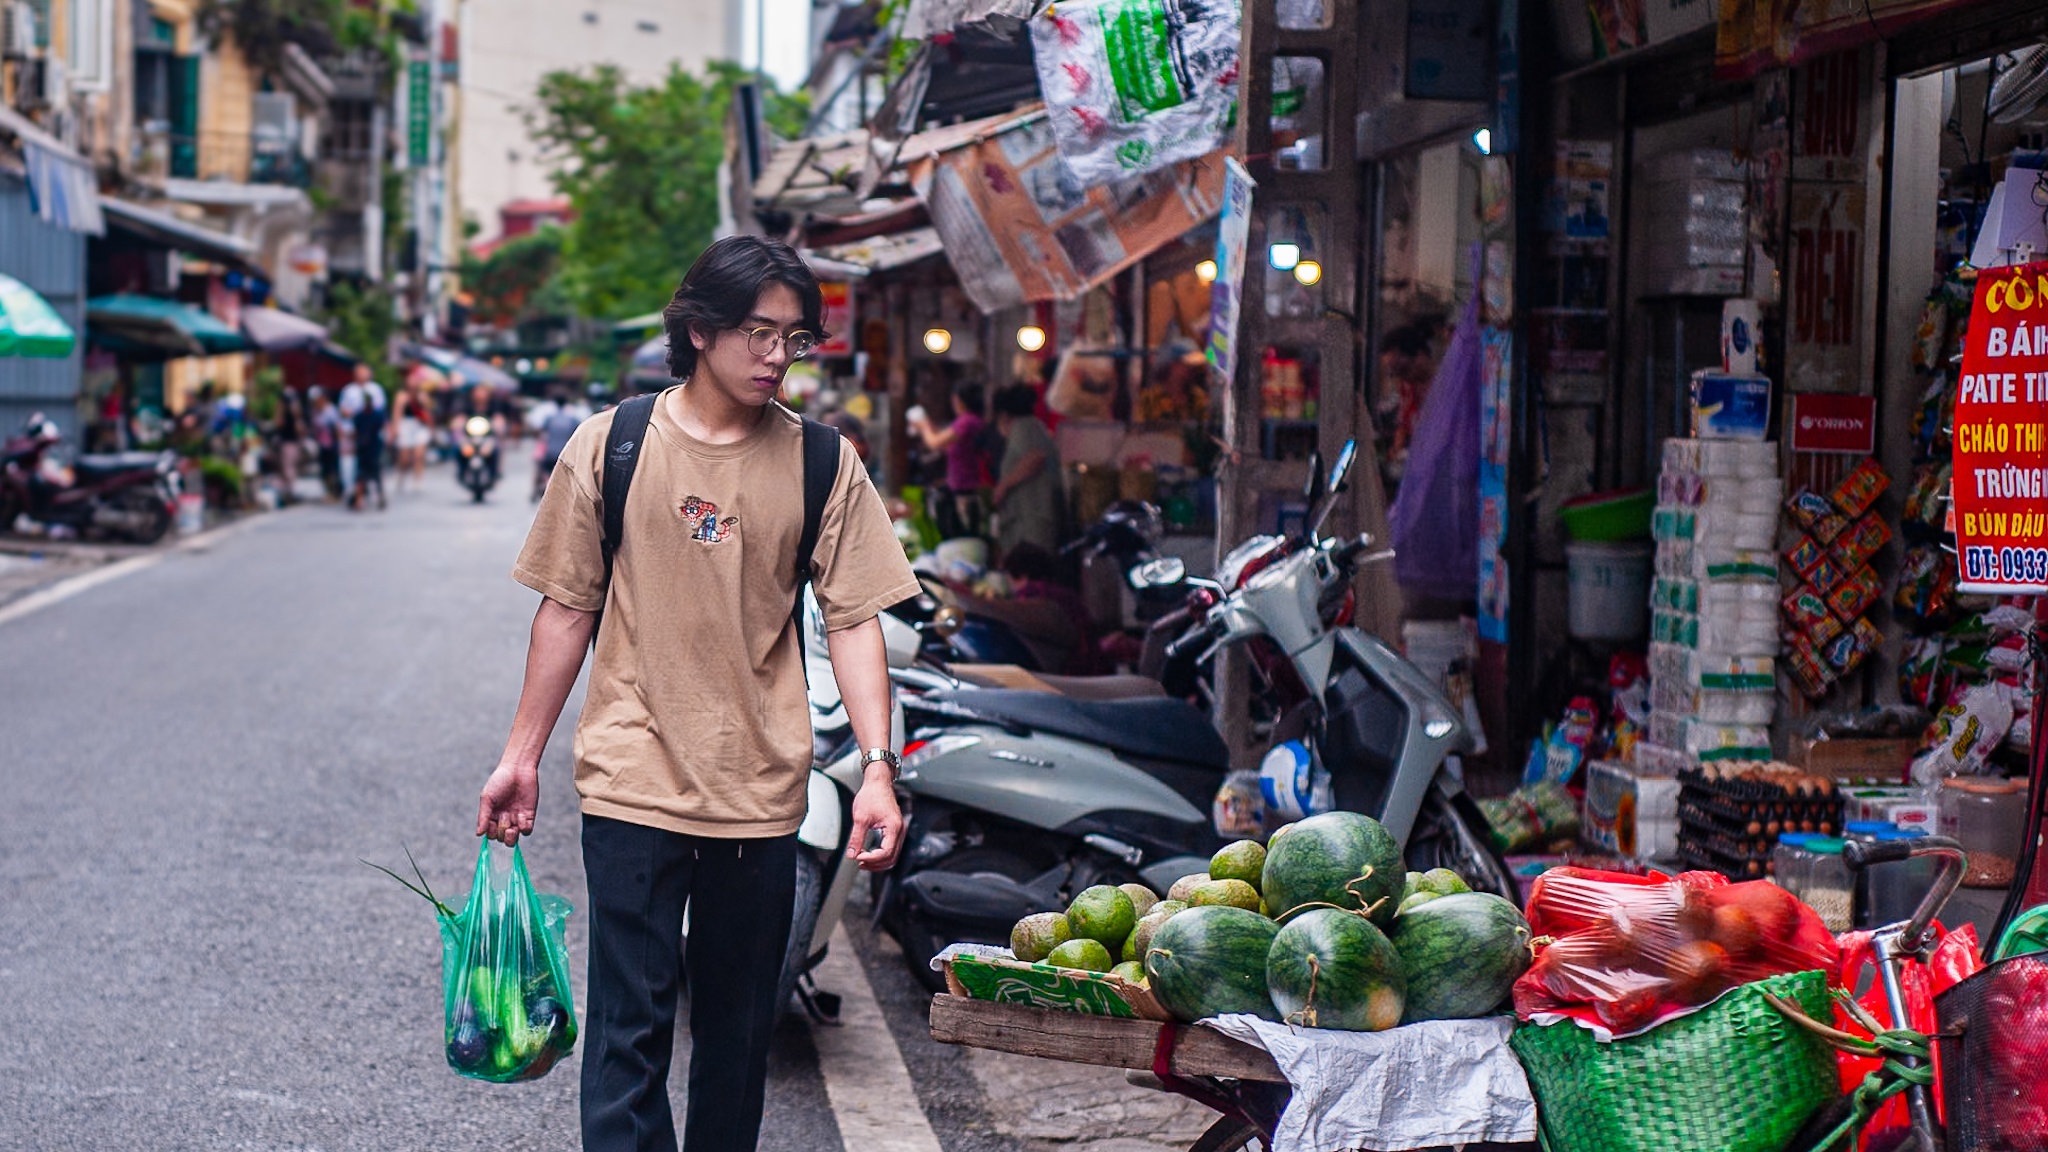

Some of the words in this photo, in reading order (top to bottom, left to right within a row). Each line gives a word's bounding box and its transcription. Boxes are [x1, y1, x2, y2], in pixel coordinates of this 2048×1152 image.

[1960, 373, 2017, 404] PATE
[1959, 417, 2009, 453] CHÁO
[1964, 507, 2007, 537] BÚN
[2011, 507, 2045, 542] ĐẬU
[1966, 546, 2000, 580] ĐT:
[2001, 547, 2048, 581] 0933
